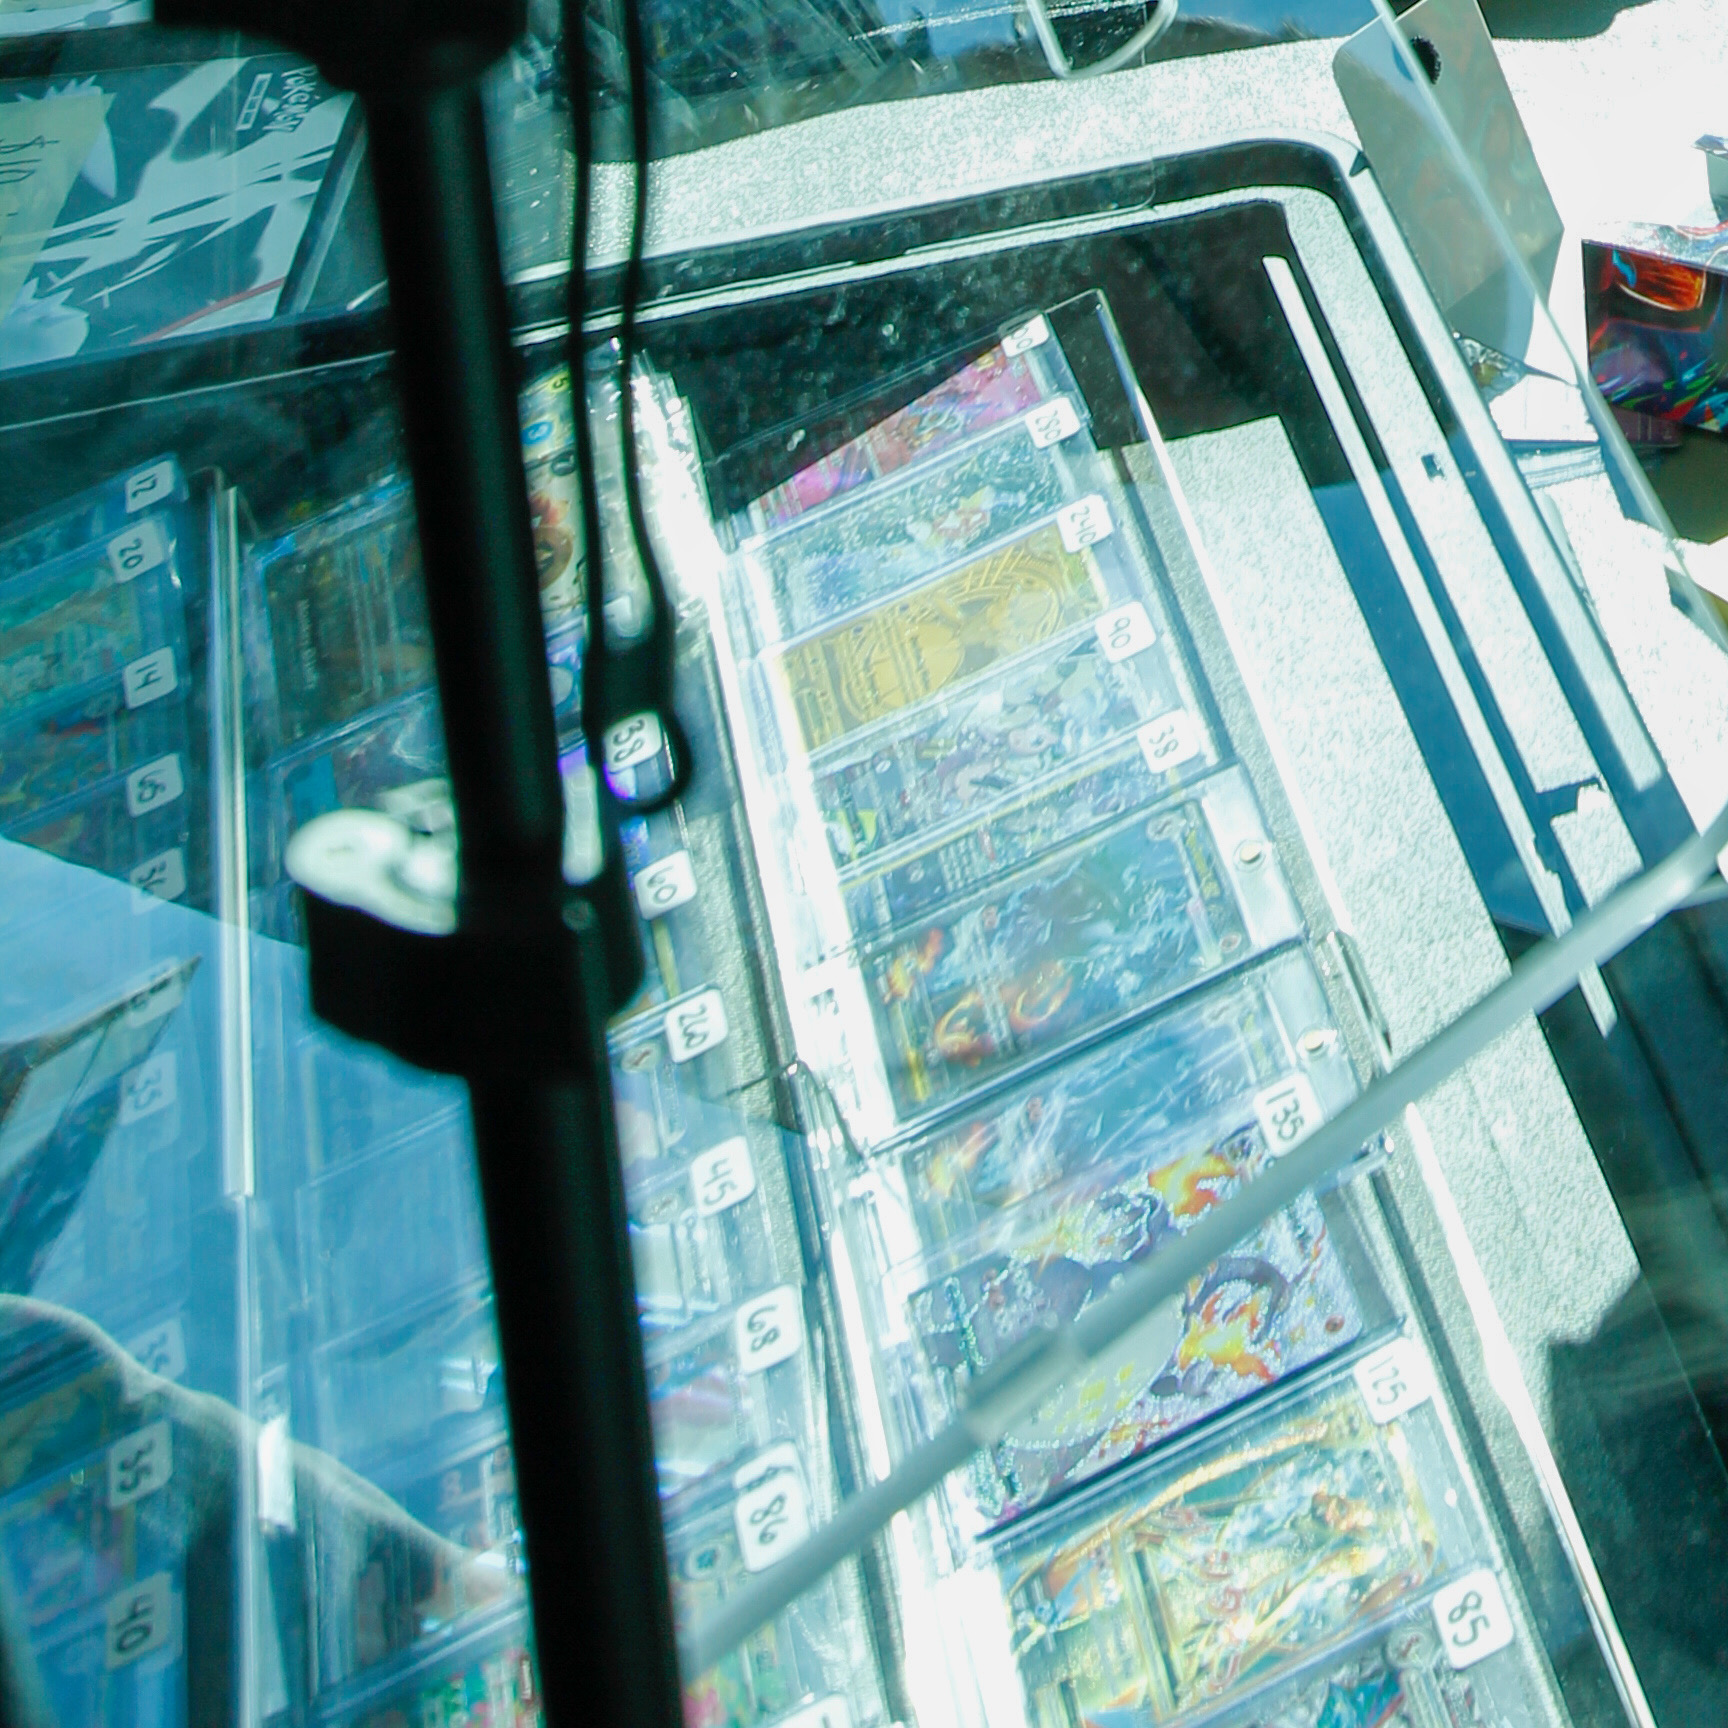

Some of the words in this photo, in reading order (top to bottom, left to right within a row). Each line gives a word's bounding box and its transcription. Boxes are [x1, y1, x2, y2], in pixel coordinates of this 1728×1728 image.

[119, 537, 143, 570] 20
[1107, 615, 1132, 650] 90
[612, 718, 647, 764] 38
[1148, 724, 1180, 760] 38
[646, 866, 680, 907] 60
[1270, 1086, 1305, 1144] 135
[702, 1156, 738, 1209] 45
[747, 1304, 778, 1355] 68
[1365, 1354, 1407, 1409] 125
[117, 1445, 156, 1491] 35
[748, 1491, 788, 1547] 86
[112, 1595, 153, 1655] 40
[1449, 1589, 1492, 1649] 85
